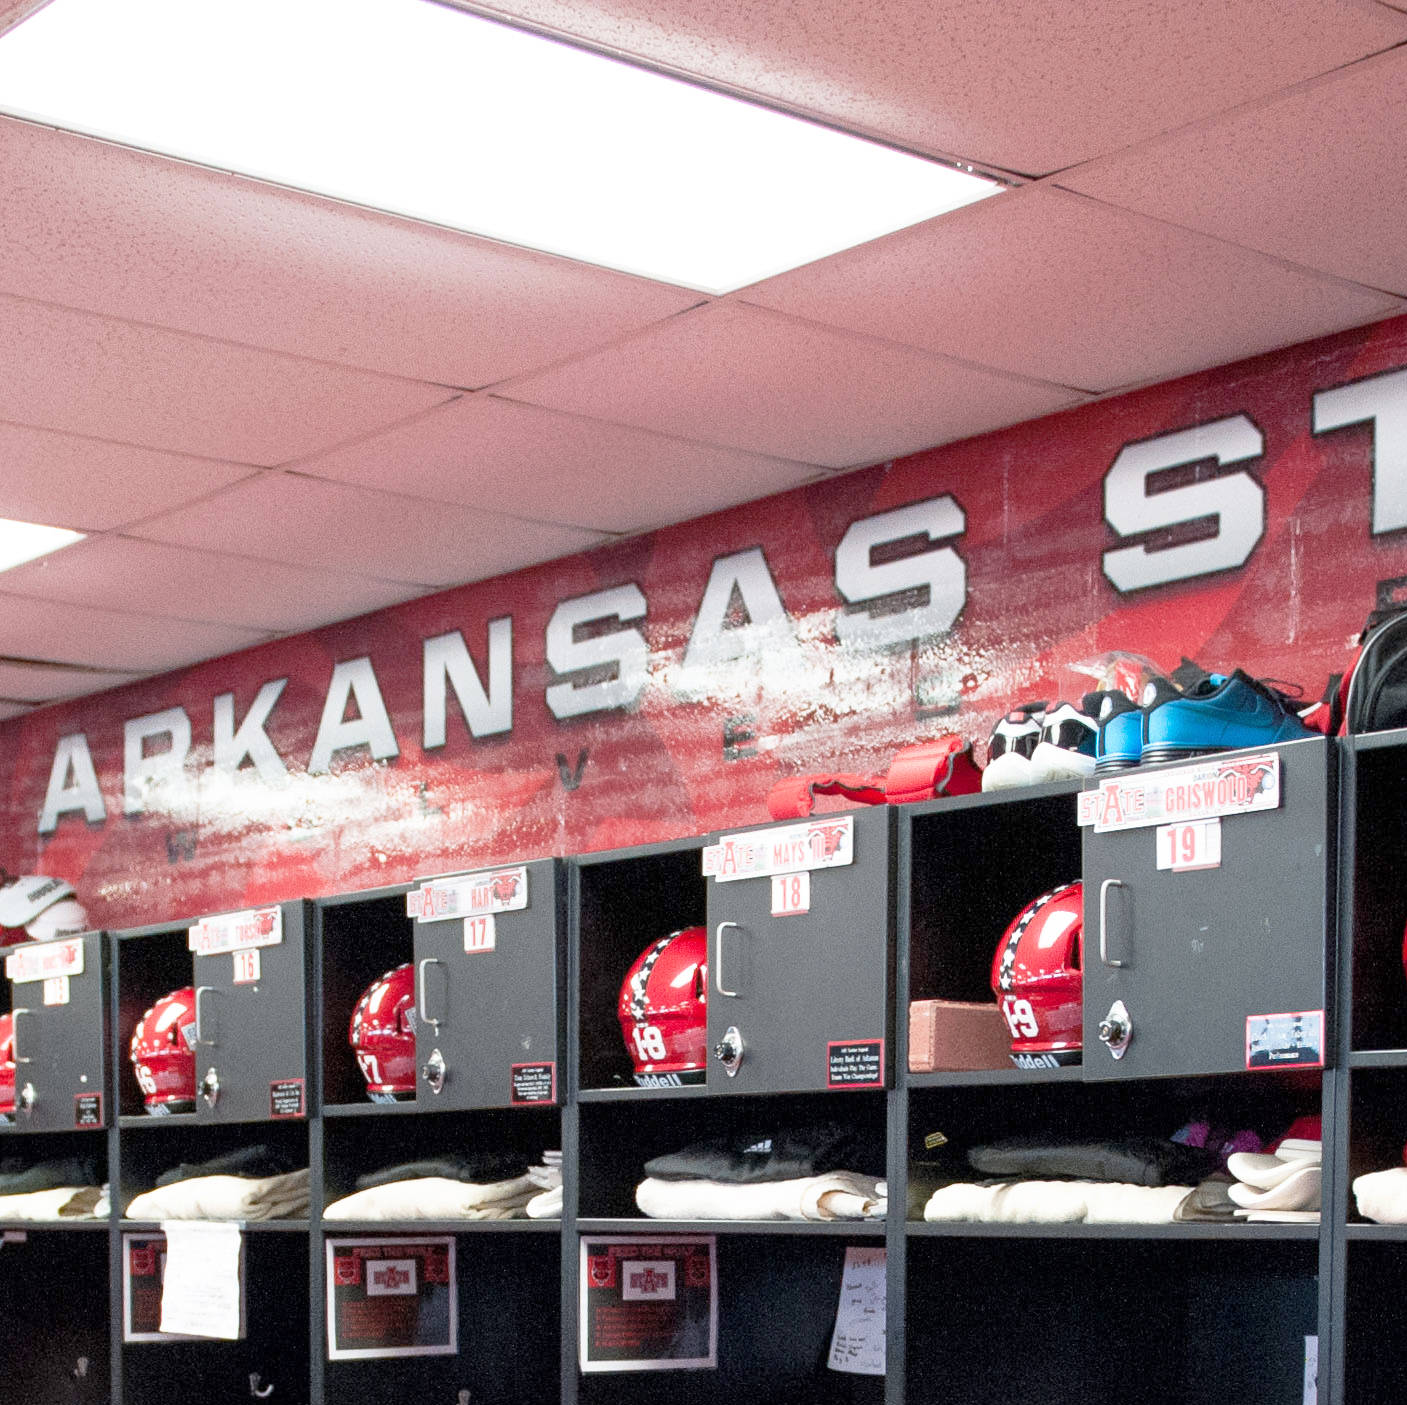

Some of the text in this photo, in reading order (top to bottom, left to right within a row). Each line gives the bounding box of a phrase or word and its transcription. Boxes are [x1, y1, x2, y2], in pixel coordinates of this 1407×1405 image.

[35, 492, 970, 838] ARKANSAS
[1080, 775, 1248, 825] STATE GRISWOLD
[773, 838, 806, 866] MAYS
[1166, 825, 1196, 865] 19
[780, 876, 801, 910] 18
[470, 917, 487, 947] 17
[241, 953, 254, 978] 16
[1002, 999, 1039, 1039] 19
[631, 1025, 667, 1061] 18
